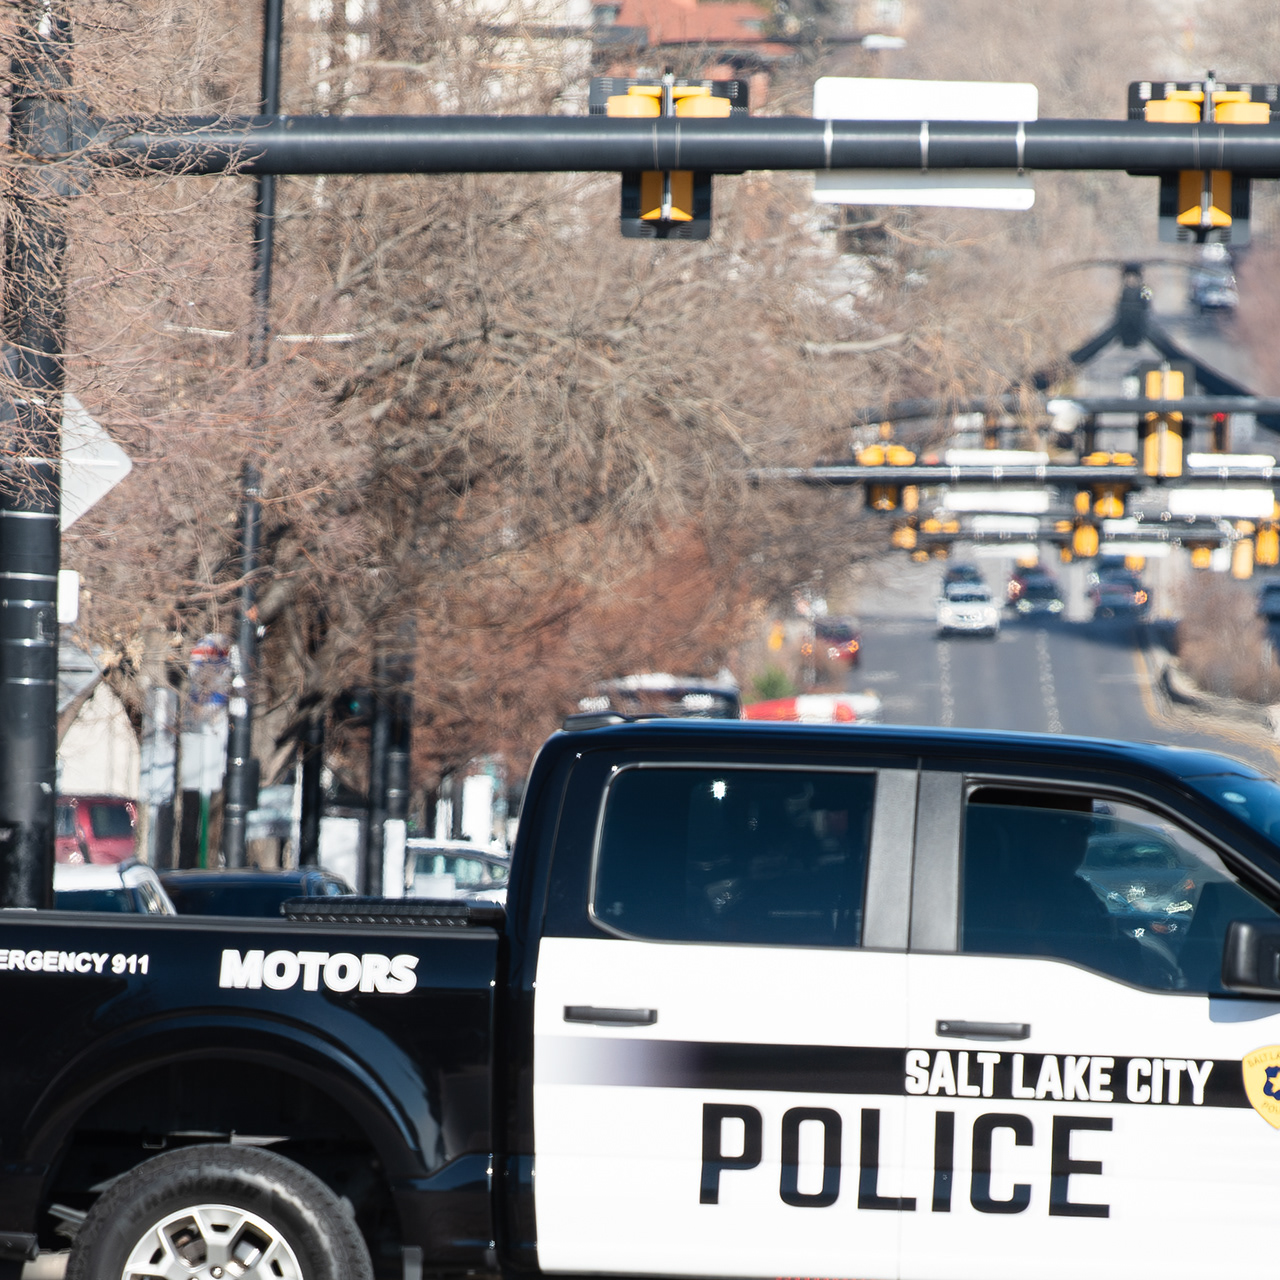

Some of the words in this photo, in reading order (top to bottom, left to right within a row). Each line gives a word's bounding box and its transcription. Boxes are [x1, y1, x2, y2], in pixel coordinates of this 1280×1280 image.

[111, 953, 150, 975] 911
[219, 949, 420, 994] MOTORS
[905, 1049, 1001, 1098] SALT
[1011, 1053, 1115, 1102] LAKE
[1126, 1057, 1214, 1105] CITY
[699, 1102, 1114, 1219] POLICE
